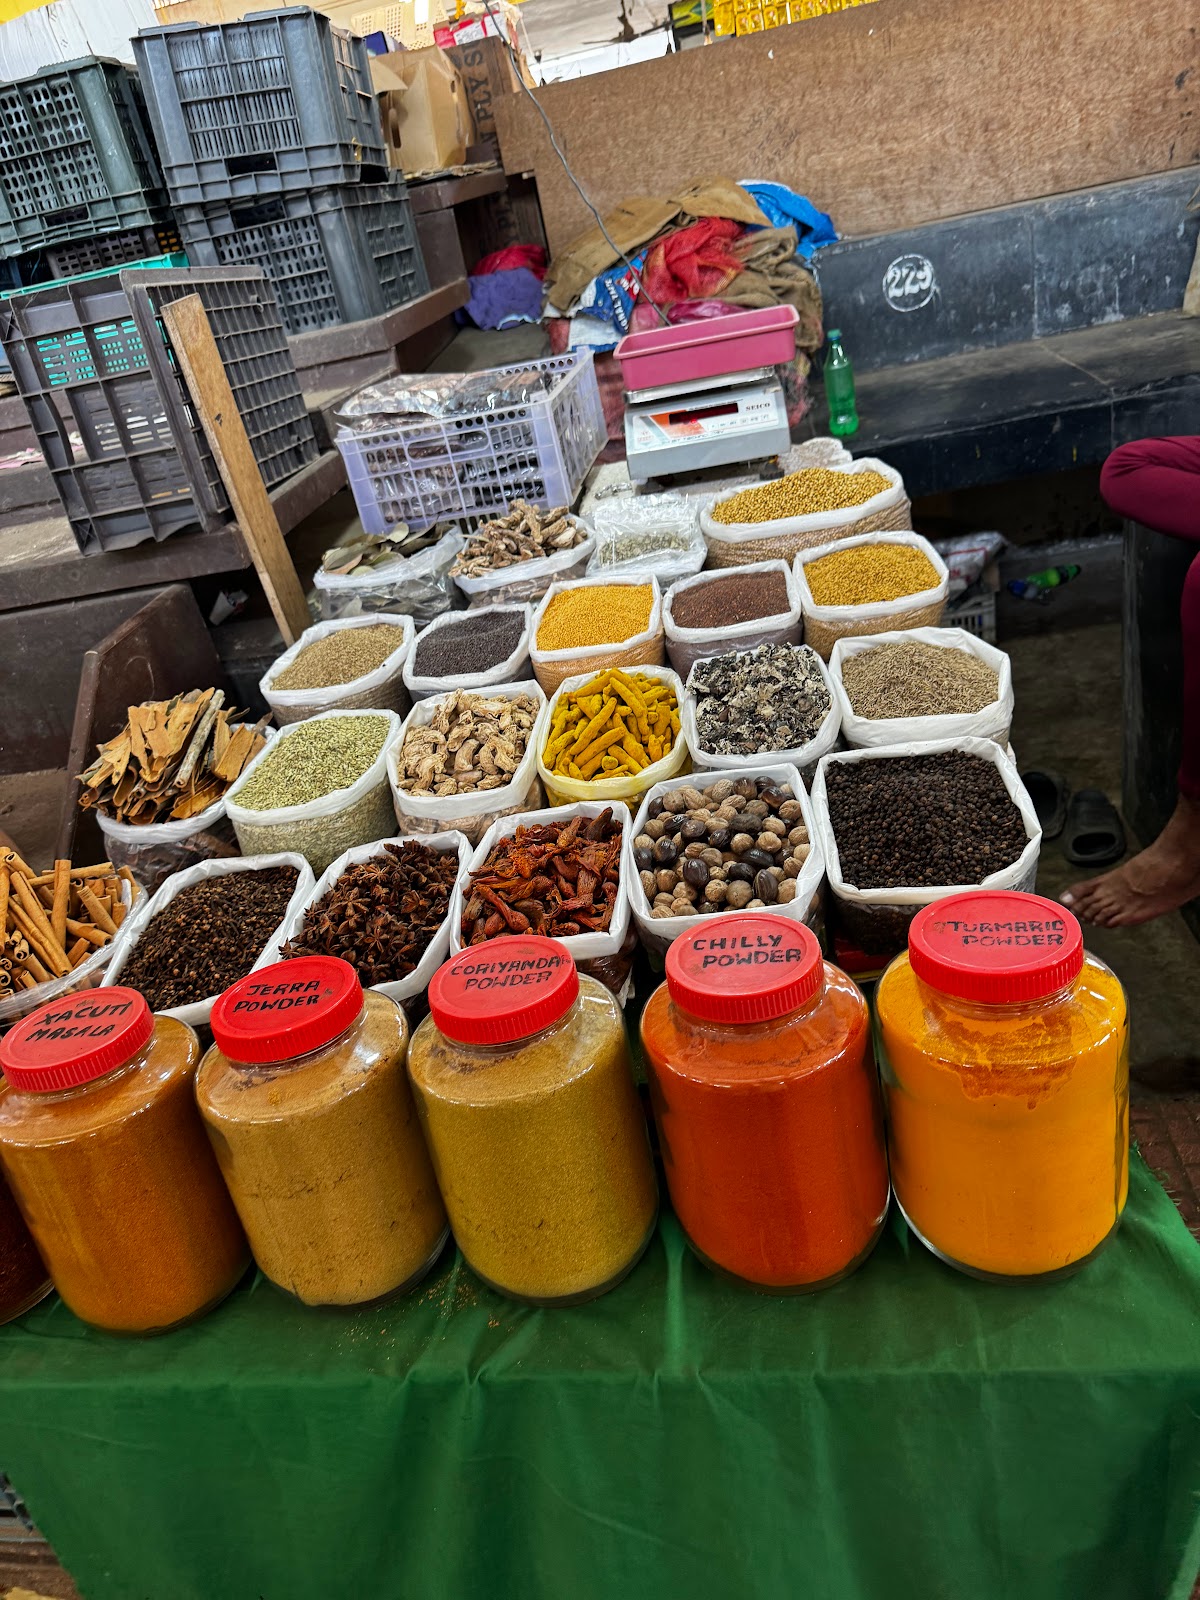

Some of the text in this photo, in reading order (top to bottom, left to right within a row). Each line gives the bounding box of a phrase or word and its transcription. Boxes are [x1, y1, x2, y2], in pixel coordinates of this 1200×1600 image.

[745, 402, 771, 412] SEICO
[946, 919, 1066, 933] TURMARIC
[693, 934, 783, 951] CHILLY
[961, 933, 1064, 946] POWDER
[702, 948, 801, 969] POWDER
[246, 980, 320, 996] JERRA
[464, 970, 552, 991] POWDER
[232, 994, 320, 1013] POWDER
[33, 1000, 134, 1027] XACUTI
[24, 1024, 116, 1042] MASALA
